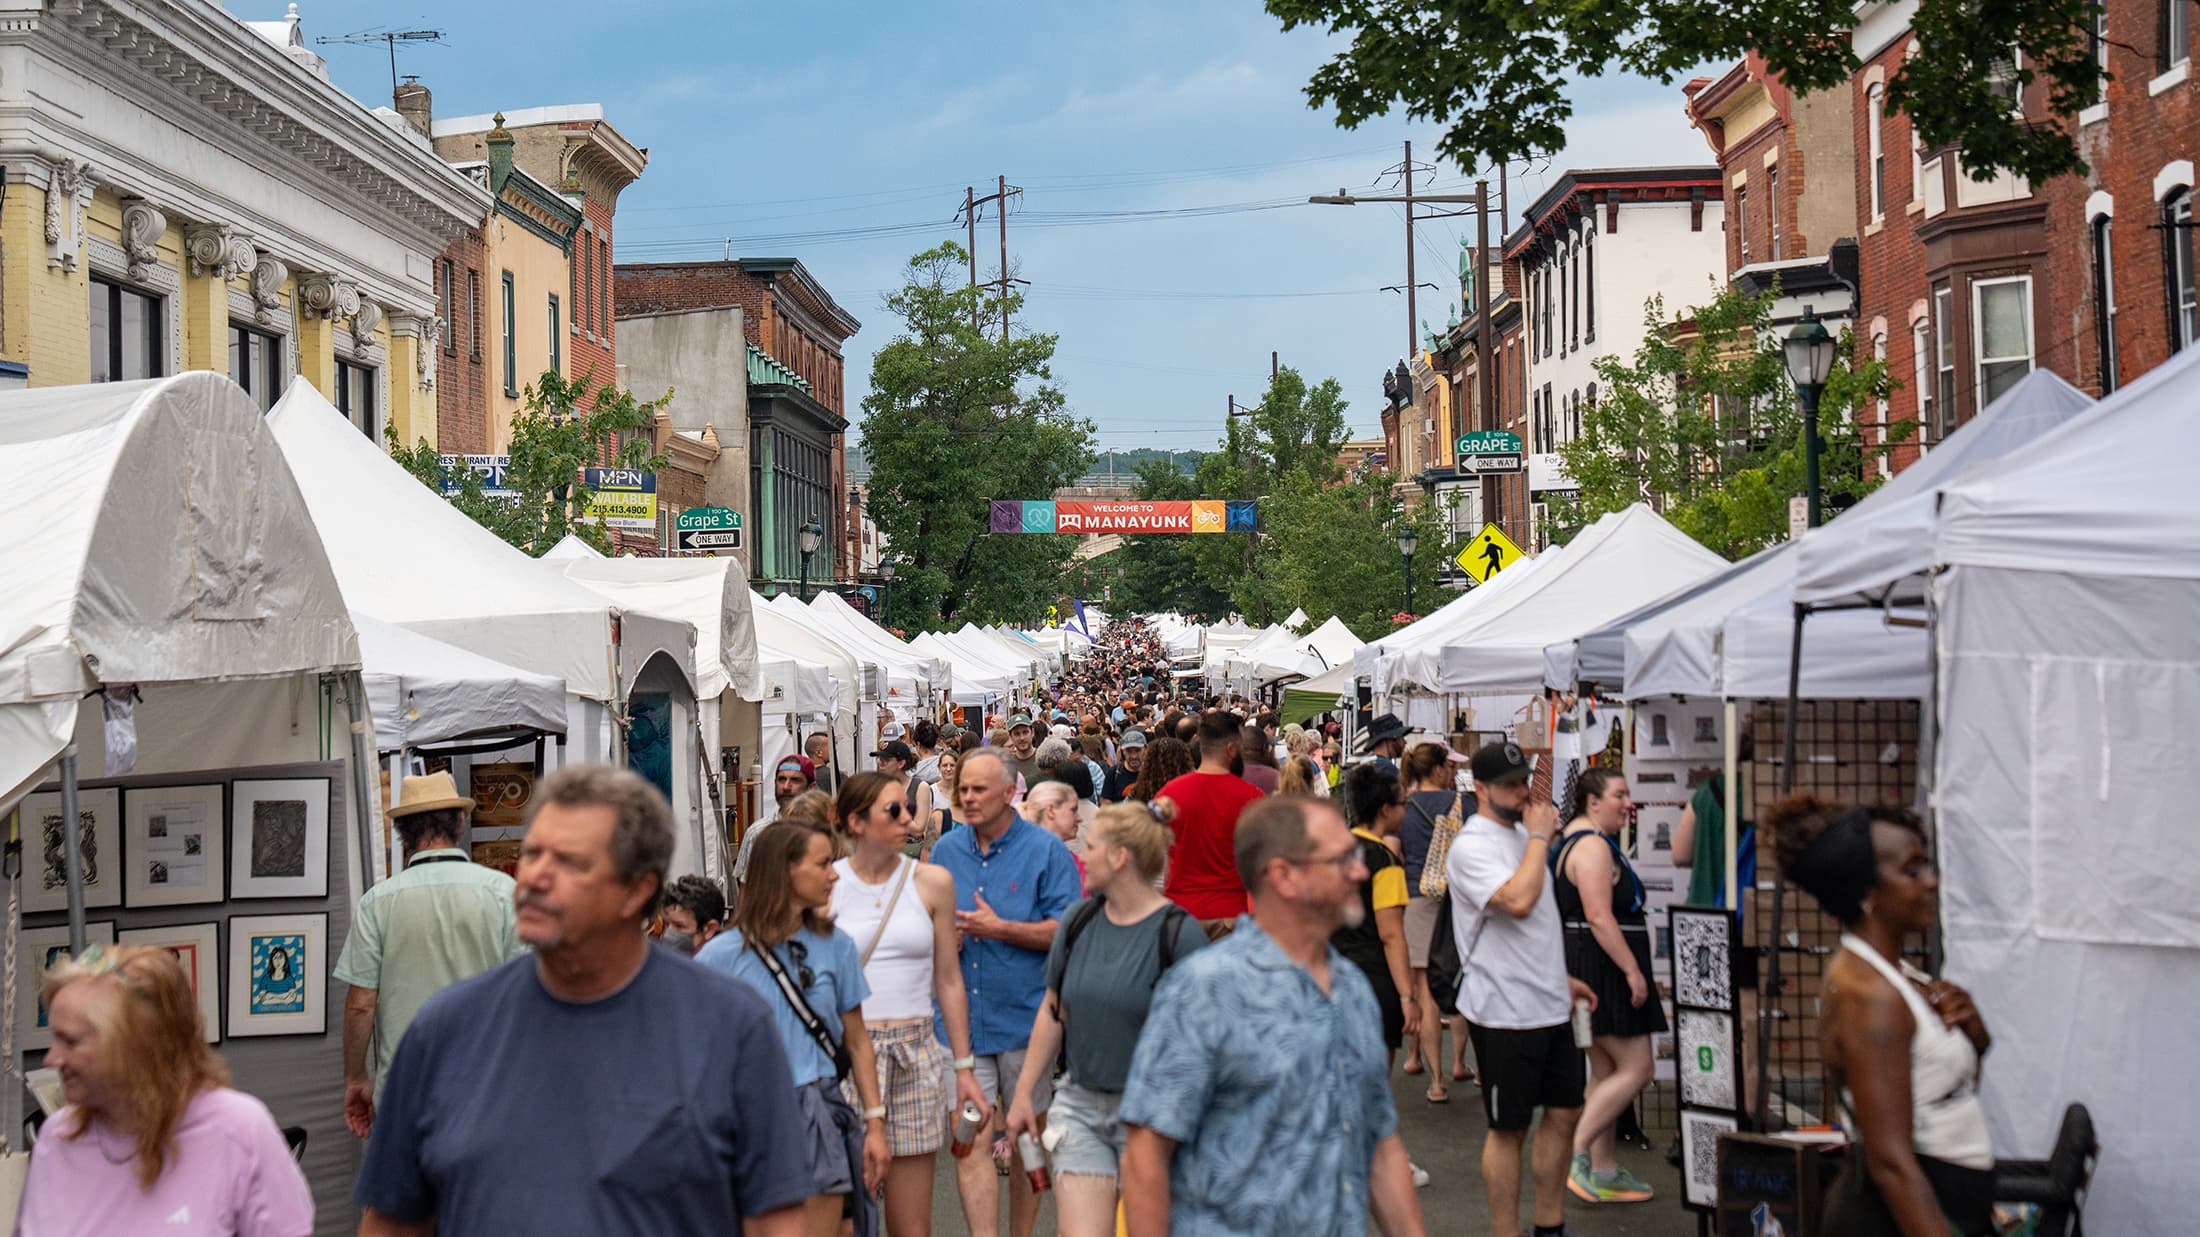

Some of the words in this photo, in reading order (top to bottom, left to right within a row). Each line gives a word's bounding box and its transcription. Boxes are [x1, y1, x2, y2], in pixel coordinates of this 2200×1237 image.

[1460, 439, 1509, 452] GRAPE
[1512, 442, 1521, 451] ST
[440, 456, 490, 465] RESTURANT
[498, 457, 509, 465] RE
[1477, 459, 1495, 468] ONE
[1497, 458, 1515, 467] WAY
[600, 471, 642, 484] MPN
[593, 493, 651, 505] AVAILABLE
[593, 505, 647, 514] 215.413.4900
[680, 515, 719, 529] Grape
[725, 513, 738, 525] St
[1085, 515, 1189, 528] MANAYUNK
[695, 535, 712, 544] ONE
[714, 534, 731, 544] WAY
